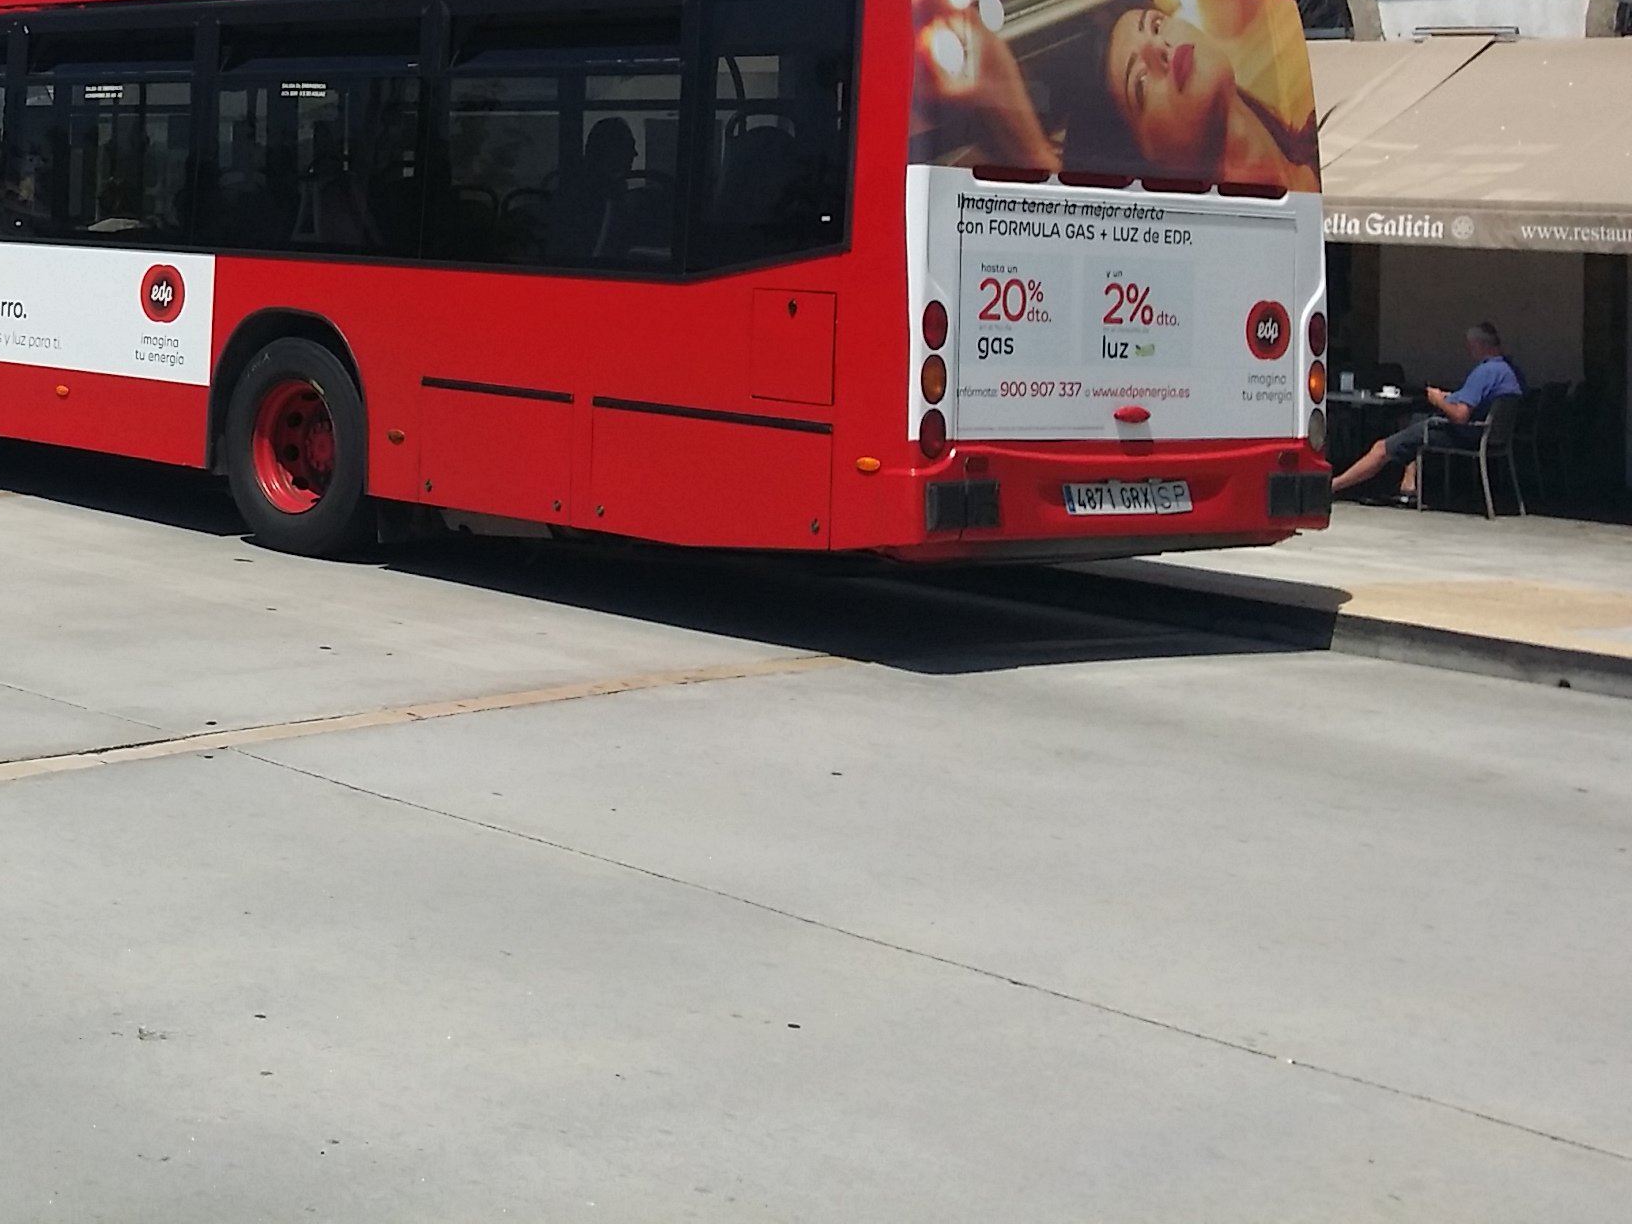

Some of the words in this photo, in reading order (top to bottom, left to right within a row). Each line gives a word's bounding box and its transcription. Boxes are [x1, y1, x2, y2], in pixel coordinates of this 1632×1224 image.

[957, 193, 1018, 214] Imagina
[1021, 198, 1061, 214] tener
[1064, 199, 1077, 215] la
[1081, 201, 1120, 220] mejor
[1123, 203, 1164, 221] oferta
[957, 220, 984, 236] con
[989, 220, 1061, 238] FORMULA
[1065, 223, 1095, 240] GAS
[1100, 228, 1108, 241] +
[1112, 225, 1139, 243] LUZ
[1143, 227, 1159, 244] de
[1164, 229, 1192, 245] EDP.
[1365, 212, 1444, 239] Galicia
[981, 262, 1005, 273] hasta
[1007, 265, 1018, 273] un
[151, 281, 173, 307] edp
[1103, 282, 1154, 325] 2%
[1027, 307, 1052, 323] dto.
[1156, 311, 1180, 326] dto.
[4, 333, 11, 347] y
[12, 330, 26, 347] luz
[29, 335, 51, 349] para
[141, 333, 179, 350] imagina
[1257, 317, 1279, 345] edp
[135, 350, 145, 361] tu
[977, 335, 1014, 360] gas
[1102, 335, 1129, 359] luz
[1000, 381, 1027, 398] 900
[1030, 381, 1056, 398] 907
[1058, 381, 1082, 398] 337
[1247, 373, 1286, 388] imagina
[1242, 389, 1253, 401] tu
[1077, 487, 1116, 509] 4871
[1120, 486, 1152, 510] GRX
[1157, 484, 1185, 509] SP
